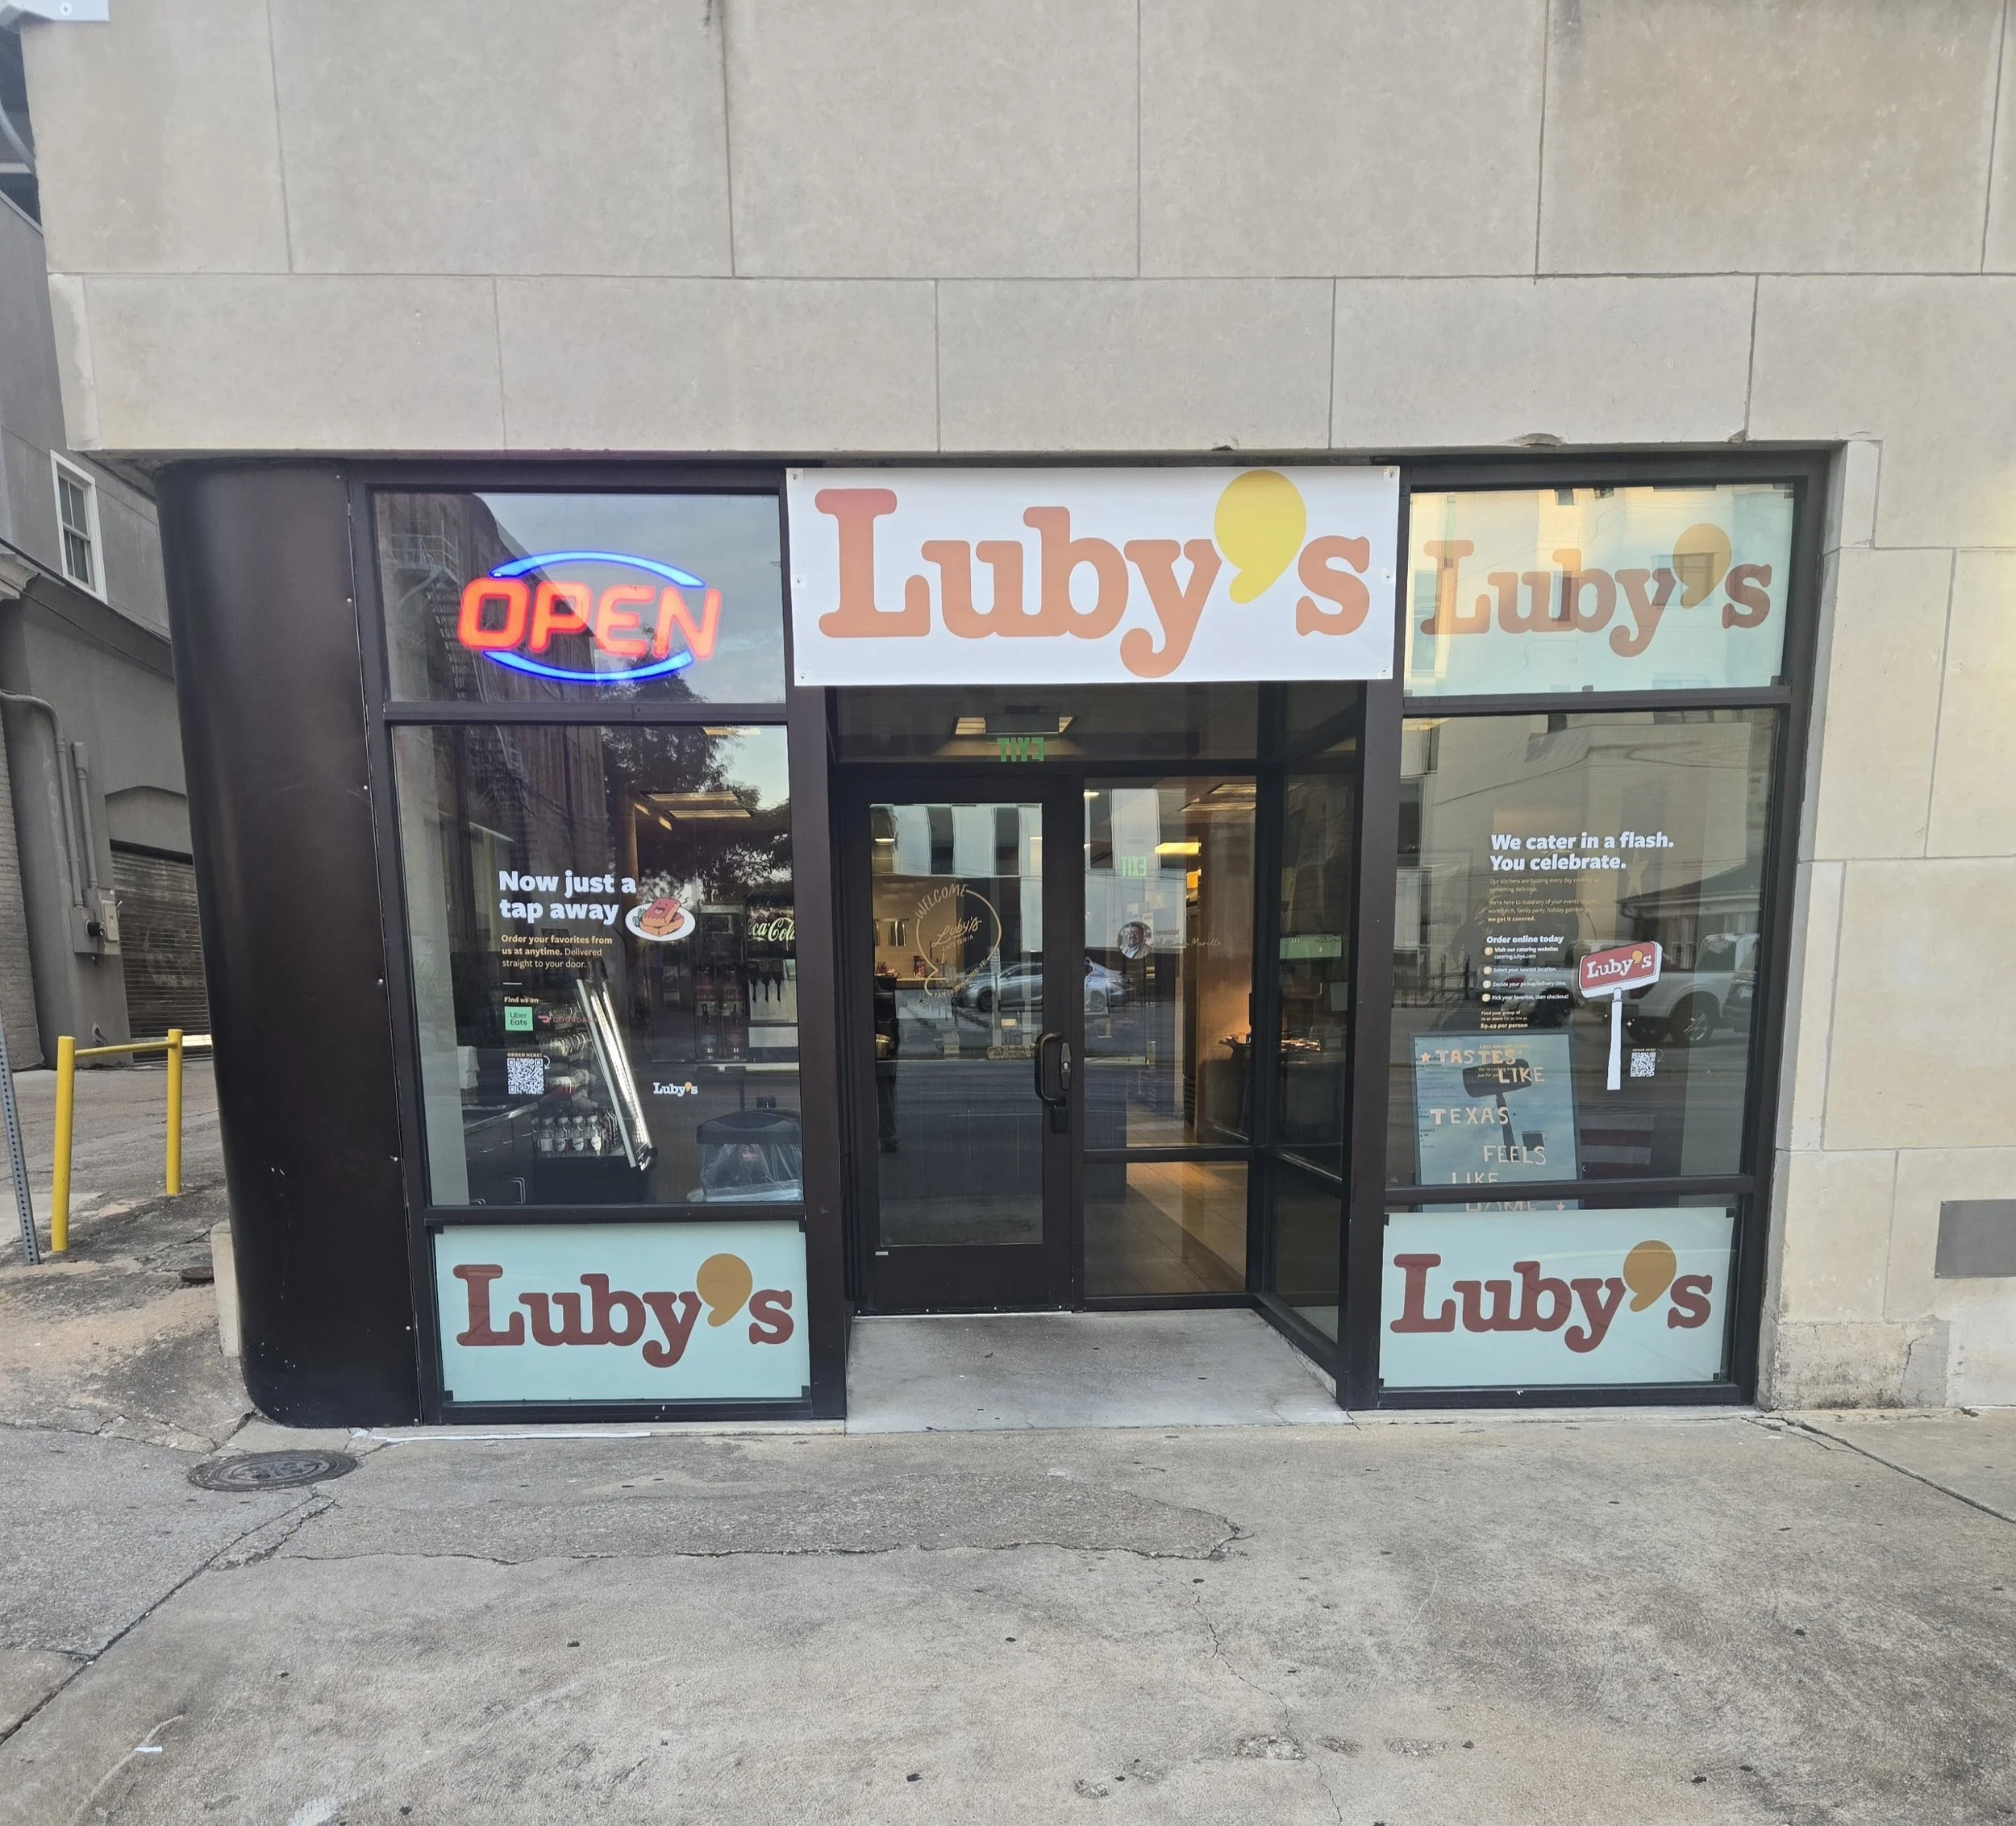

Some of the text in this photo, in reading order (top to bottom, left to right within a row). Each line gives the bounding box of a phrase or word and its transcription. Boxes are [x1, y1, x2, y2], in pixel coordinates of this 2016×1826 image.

[814, 469, 1371, 678] Luby's
[1420, 522, 1772, 658] Luby's
[457, 577, 722, 660] OPEN
[1491, 831, 1674, 850] We cater in a flash.
[1490, 854, 1627, 871] You celebrate.
[499, 869, 636, 898] Now just a
[500, 899, 619, 925] tap away
[915, 884, 968, 919] WELCOME
[528, 936, 549, 945] your
[550, 935, 589, 944] favorites
[591, 935, 612, 944] from
[931, 916, 982, 948] Luby's
[1486, 935, 1564, 944] Order online today
[524, 947, 562, 957] anytime.
[565, 948, 602, 956] Delivered
[502, 959, 532, 969] straight
[545, 961, 563, 970] your
[566, 960, 586, 968] door.
[1586, 949, 1652, 980] Luby's
[1435, 1050, 1516, 1065] TASTES
[1497, 1067, 1545, 1084] LIKE
[652, 1081, 698, 1097] Luby's
[1430, 1106, 1509, 1125] TEXAS
[1483, 1145, 1547, 1166] FEELS
[1389, 1240, 1713, 1353] Luby's
[452, 1253, 794, 1368] Luby's
